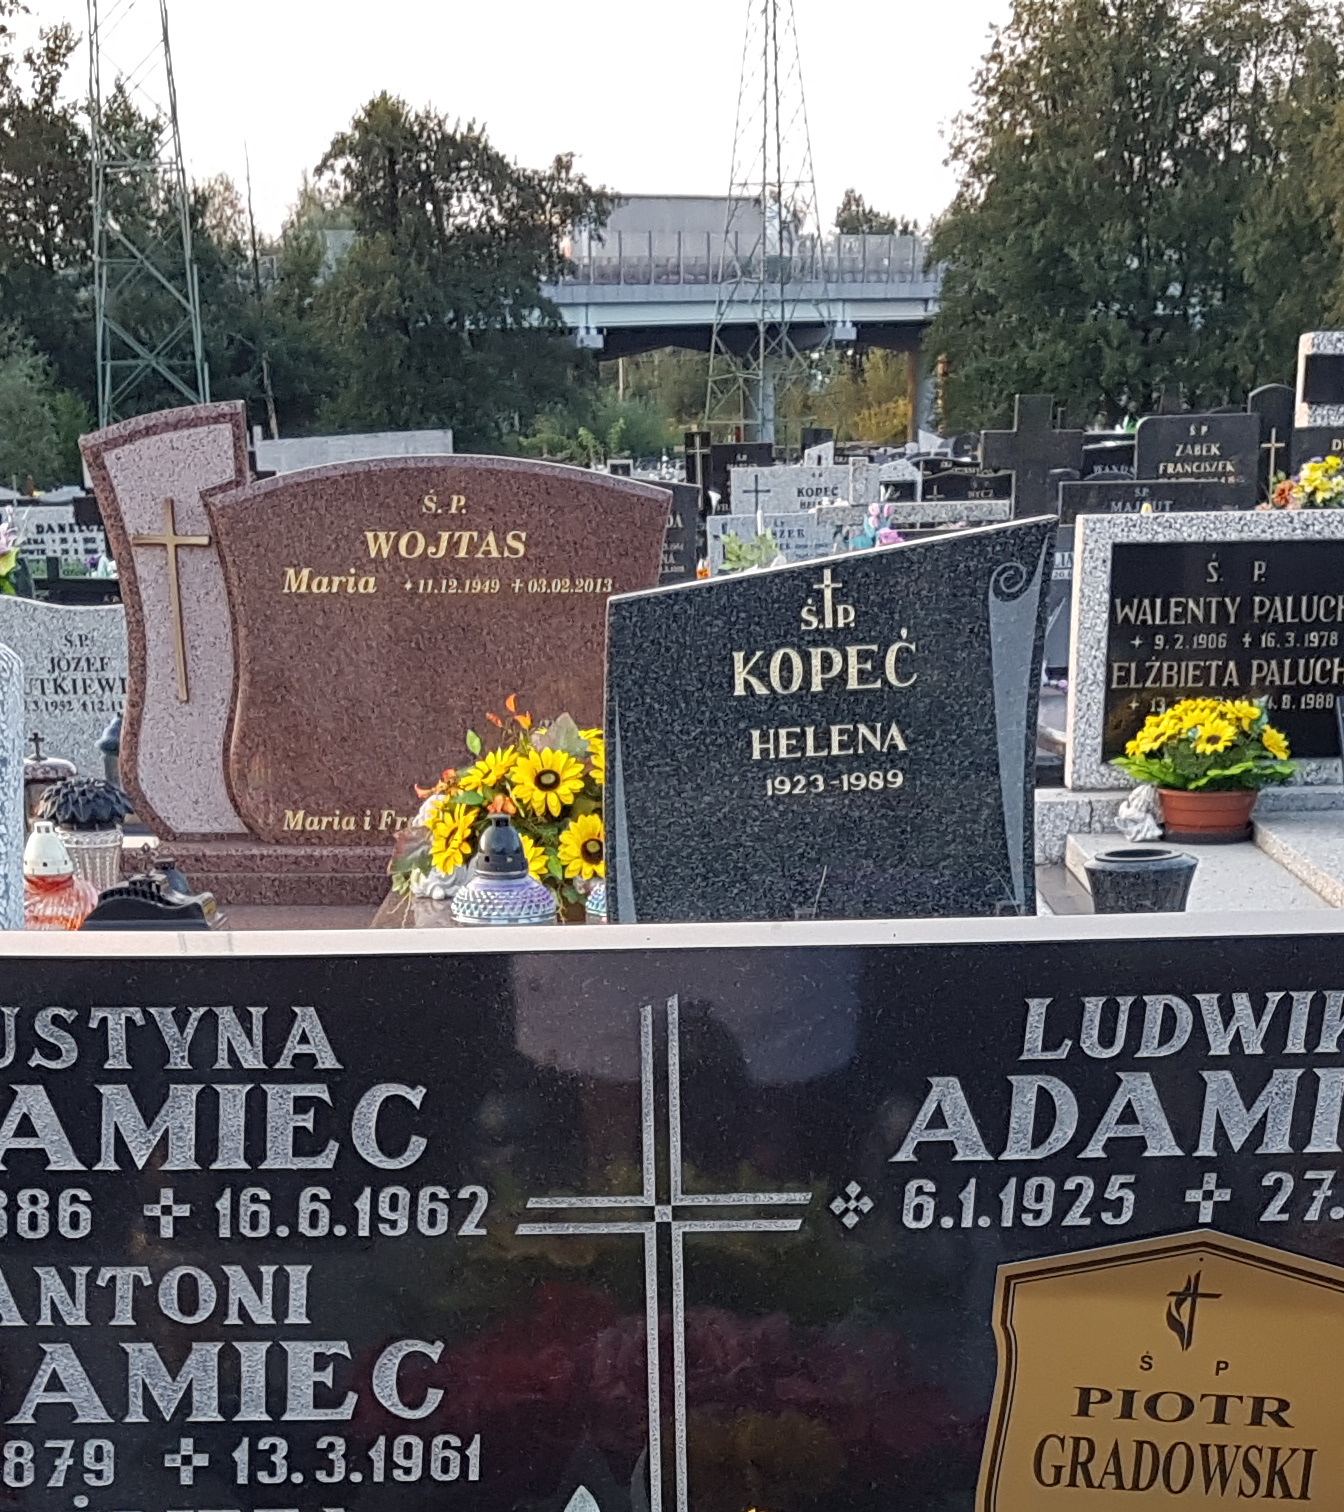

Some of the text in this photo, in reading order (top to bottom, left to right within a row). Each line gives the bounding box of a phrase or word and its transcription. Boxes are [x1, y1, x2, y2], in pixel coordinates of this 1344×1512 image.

[1110, 500, 1173, 512] MAJUT
[364, 530, 527, 559] WOJTAS
[282, 567, 614, 594] Maria 11.12.1949 03.02.2013
[1115, 596, 1241, 625] WALENTY
[732, 627, 918, 697] KOPEĆ
[1111, 656, 1240, 688] ELŻBIETA
[750, 721, 908, 760] HELENA
[766, 769, 904, 797] 1923-1989
[282, 809, 356, 832] Maria
[363, 809, 372, 832] i
[216, 1185, 490, 1238] 16.6.1962
[901, 1173, 1136, 1230] 6.1.1925
[1139, 1350, 1230, 1377] Ś P
[1070, 1386, 1296, 1429] PIOTR
[231, 1433, 482, 1486] 13.3.1961
[1033, 1433, 1319, 1501] GRADOWSKI
